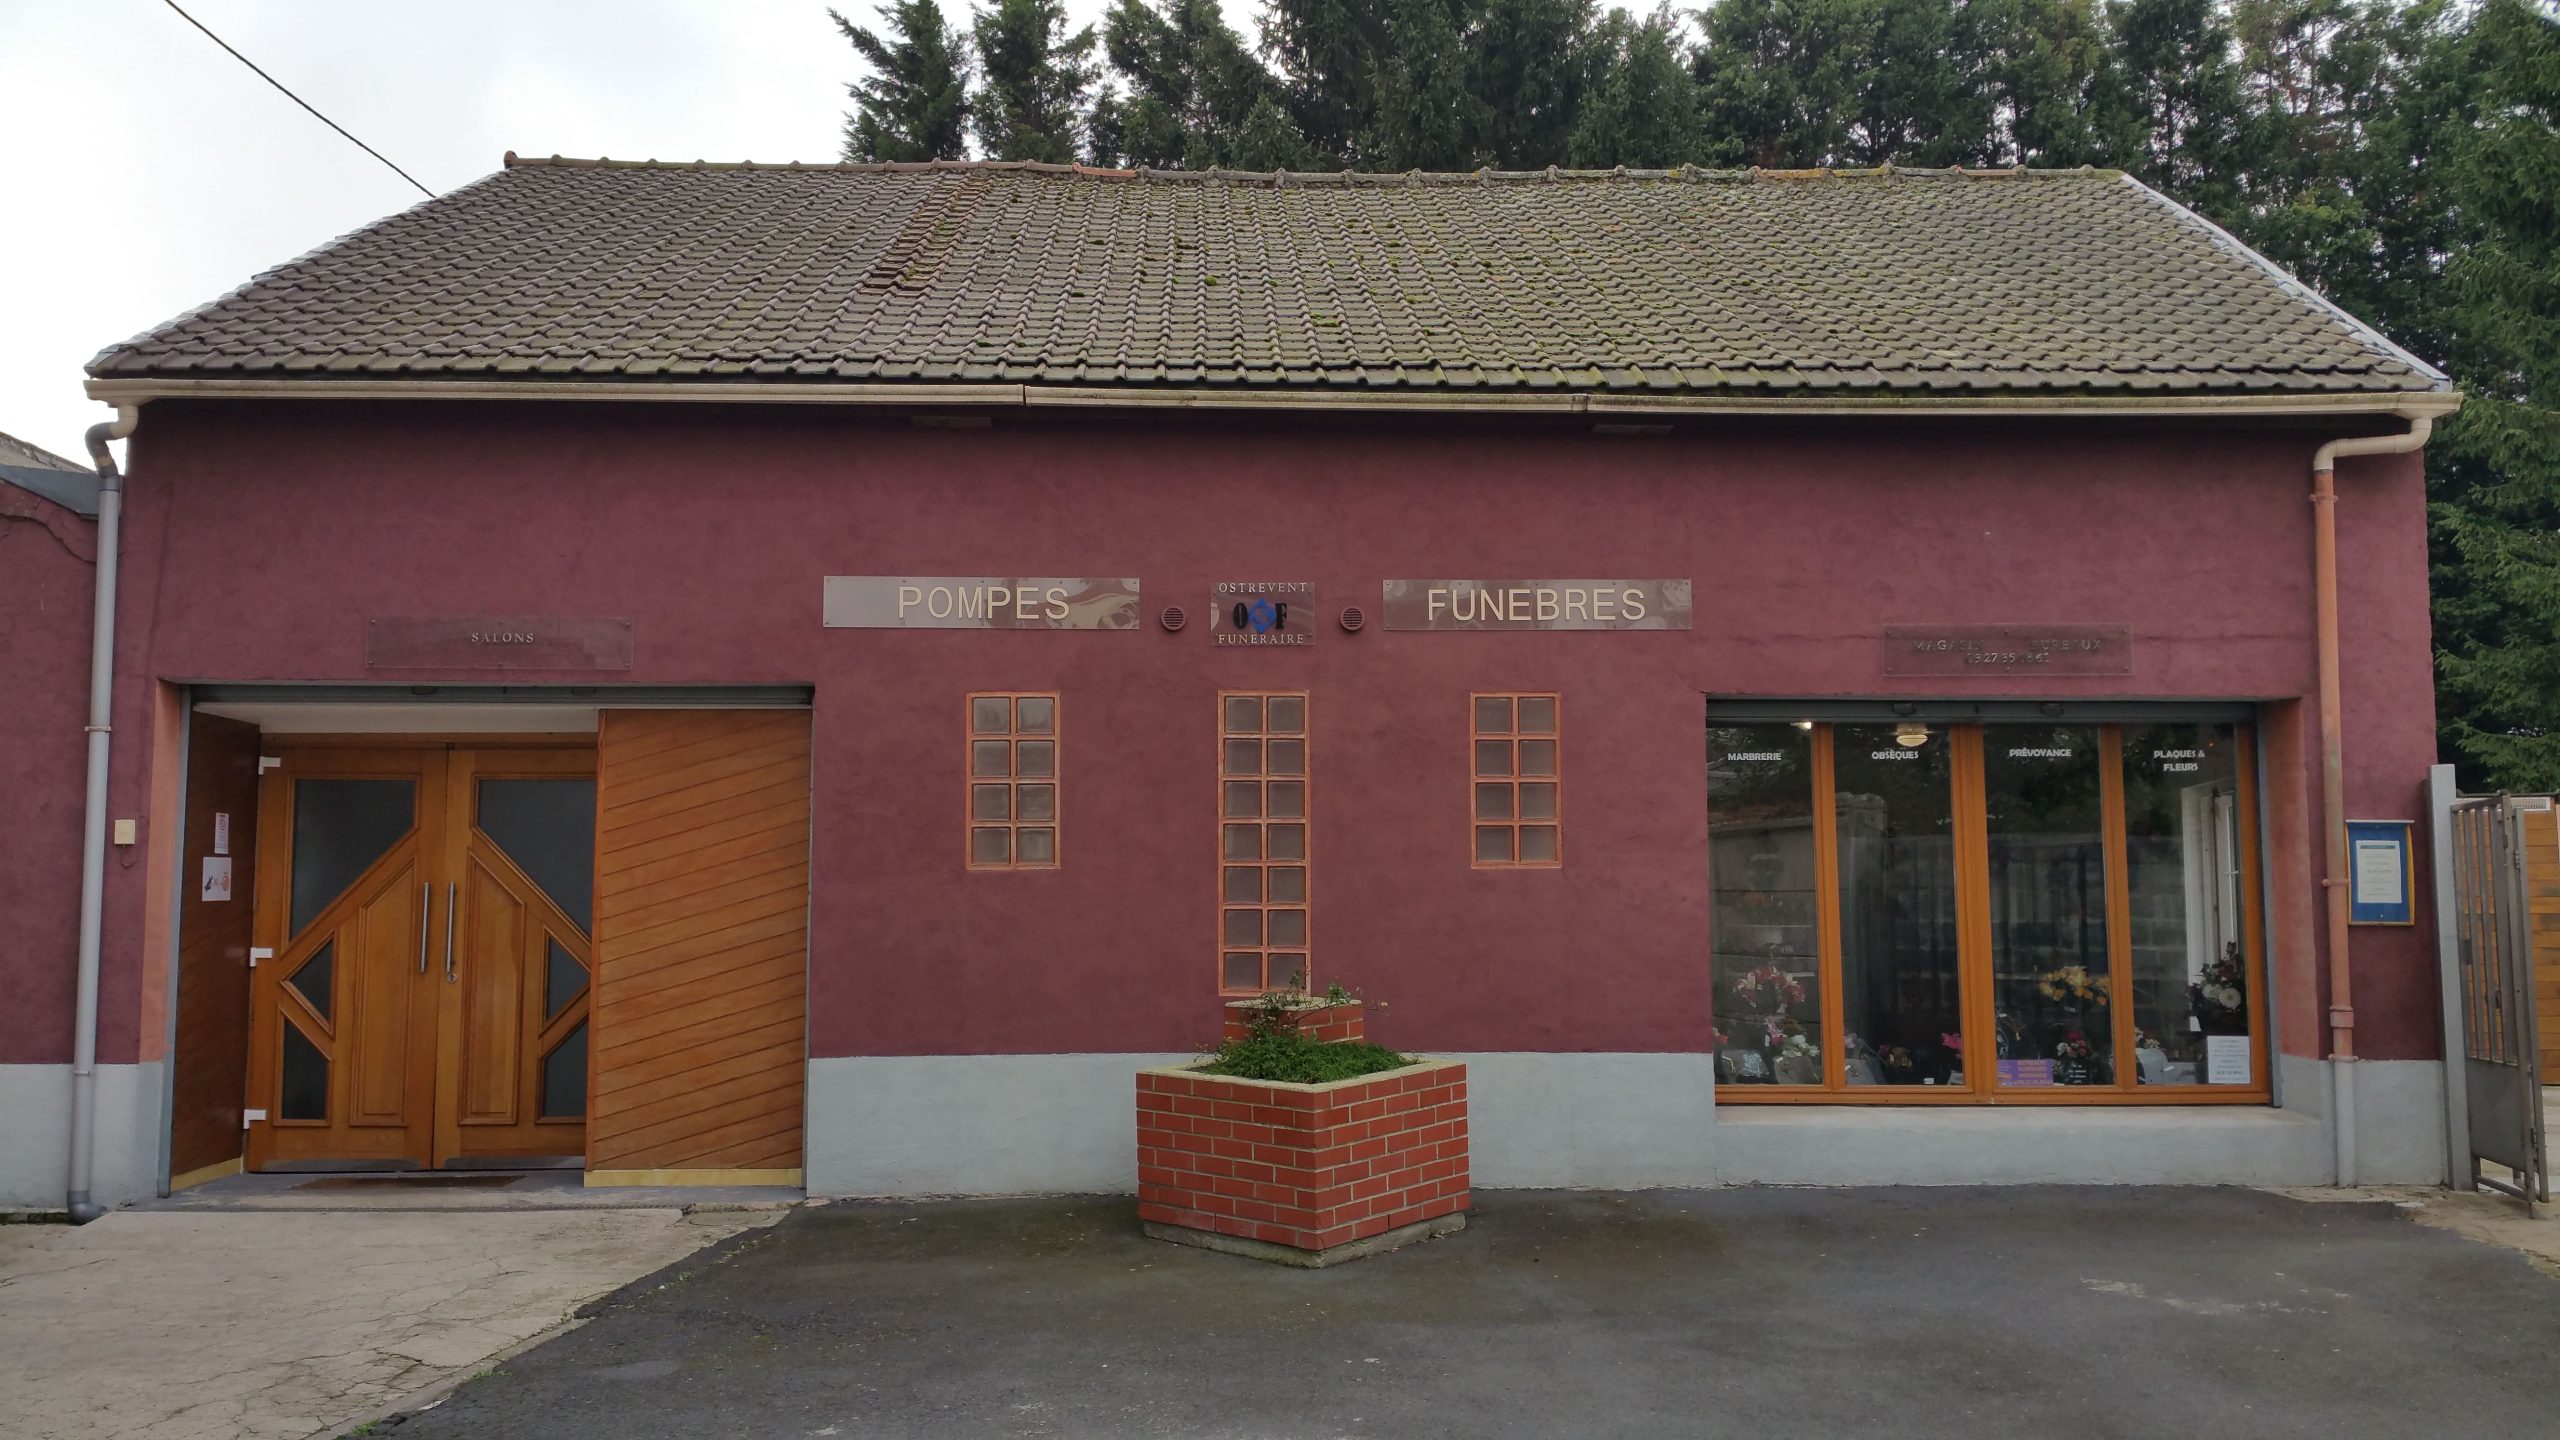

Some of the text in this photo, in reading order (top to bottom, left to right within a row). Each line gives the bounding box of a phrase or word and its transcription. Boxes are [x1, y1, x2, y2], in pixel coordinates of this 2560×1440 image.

[1218, 582, 1307, 593] OSTREVENT
[898, 586, 1070, 620] POMPES
[1428, 588, 1646, 621] FUNEBRES
[471, 632, 534, 643] SALONS
[1218, 634, 1304, 644] FUNERAIRE
[1727, 752, 1782, 761] MARBRERIE
[1871, 750, 1919, 760] OBSÈQUES
[2009, 747, 2072, 758] PRÉVOYANCE
[2153, 750, 2206, 759] PLAQUES &
[2163, 763, 2199, 772] FLEURS
